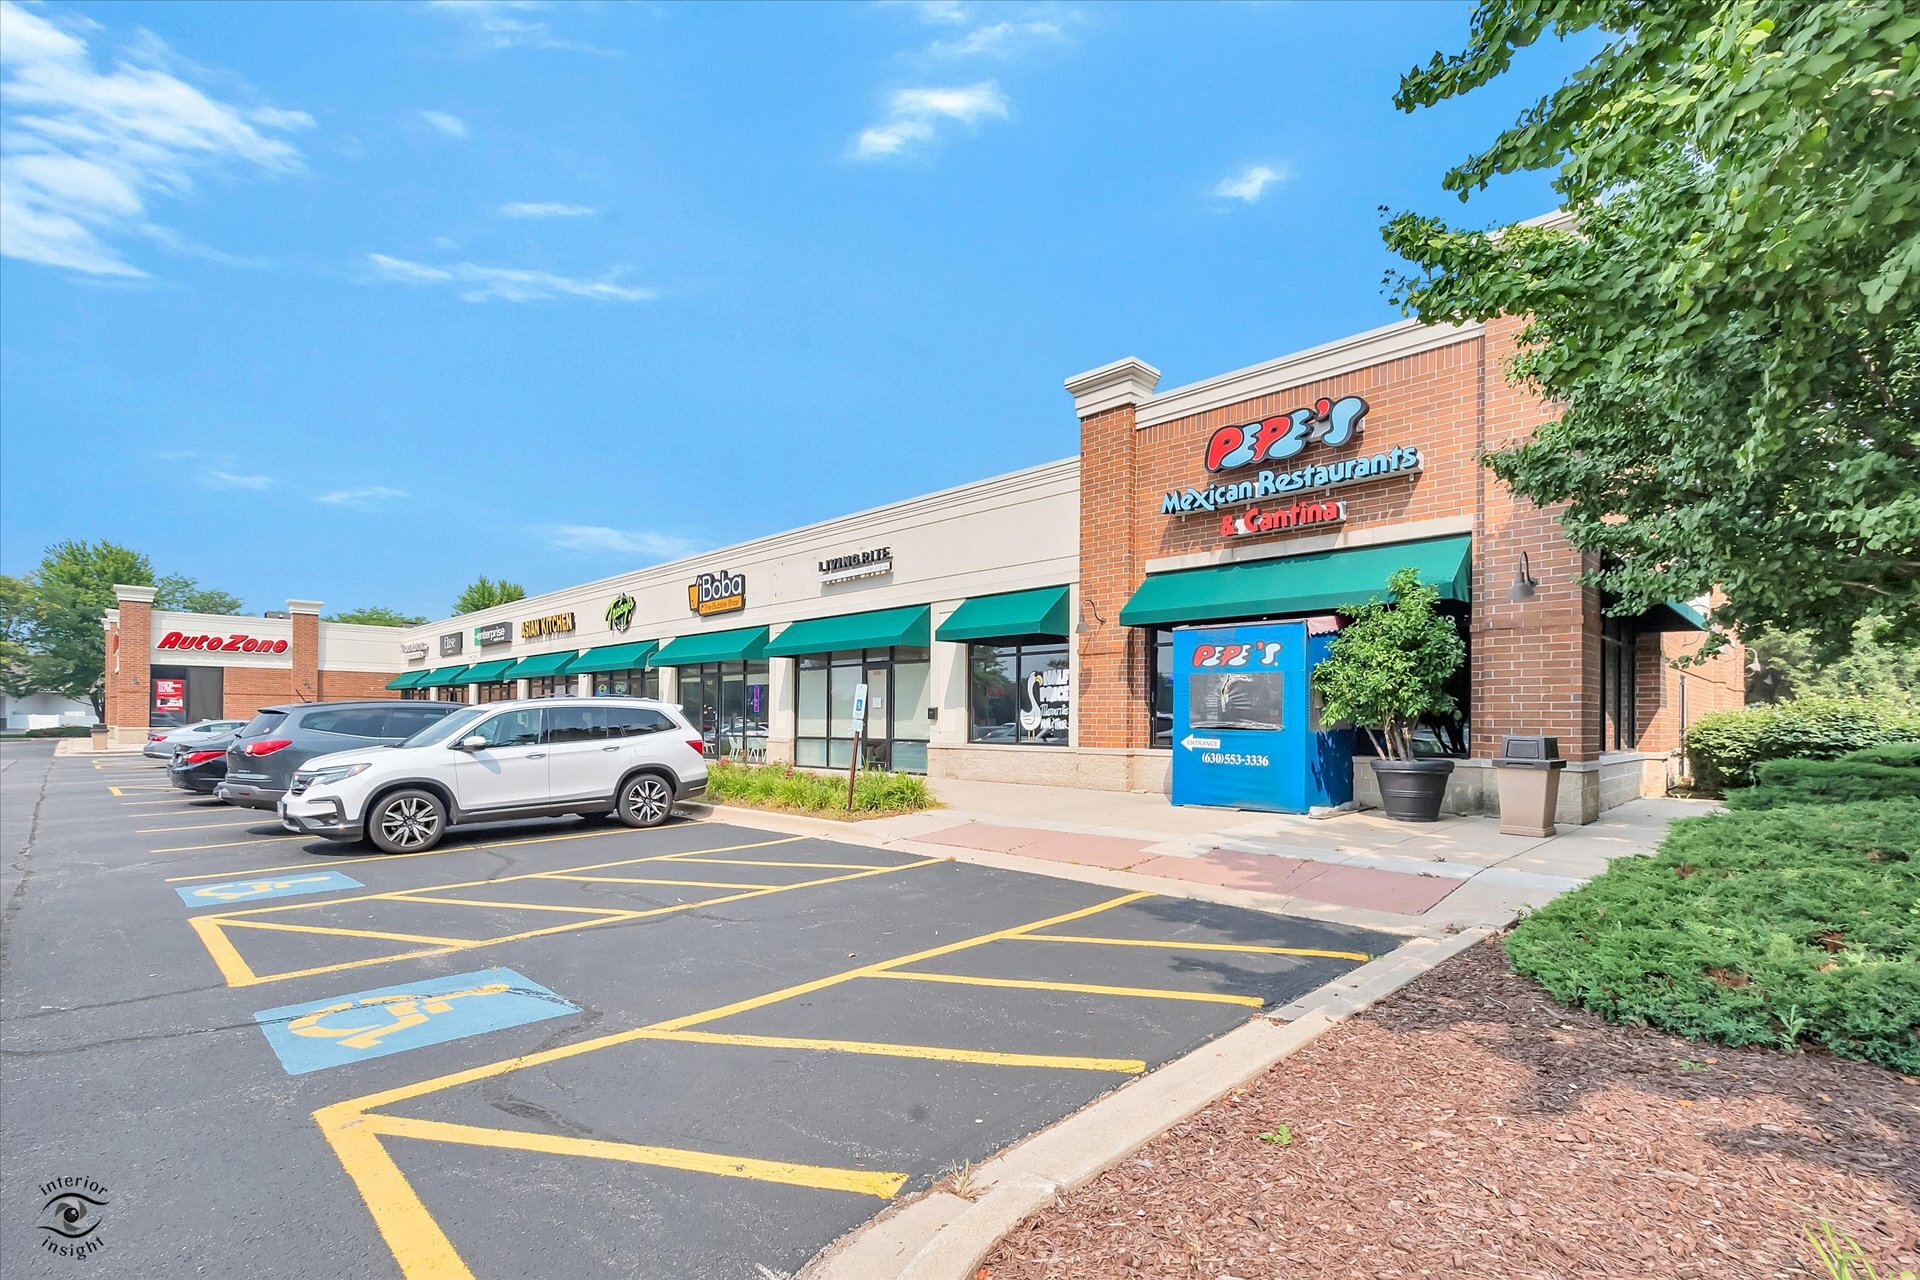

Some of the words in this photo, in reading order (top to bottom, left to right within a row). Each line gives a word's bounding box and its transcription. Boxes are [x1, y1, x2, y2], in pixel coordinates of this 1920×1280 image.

[1205, 396, 1369, 473] PEPE'S
[1160, 479, 1254, 515] Mexican
[1257, 444, 1420, 495] Restaurants
[1220, 514, 1239, 537] &
[1243, 501, 1341, 532] Cantina
[699, 572, 742, 602] iBoba
[477, 626, 506, 641] enterprise
[521, 619, 541, 638] ASIAN
[541, 612, 575, 634] KITCHEN
[157, 631, 289, 654] AutoZone
[1192, 641, 1283, 668] PEPE'S
[1202, 752, 1269, 767] (630)553-3336
